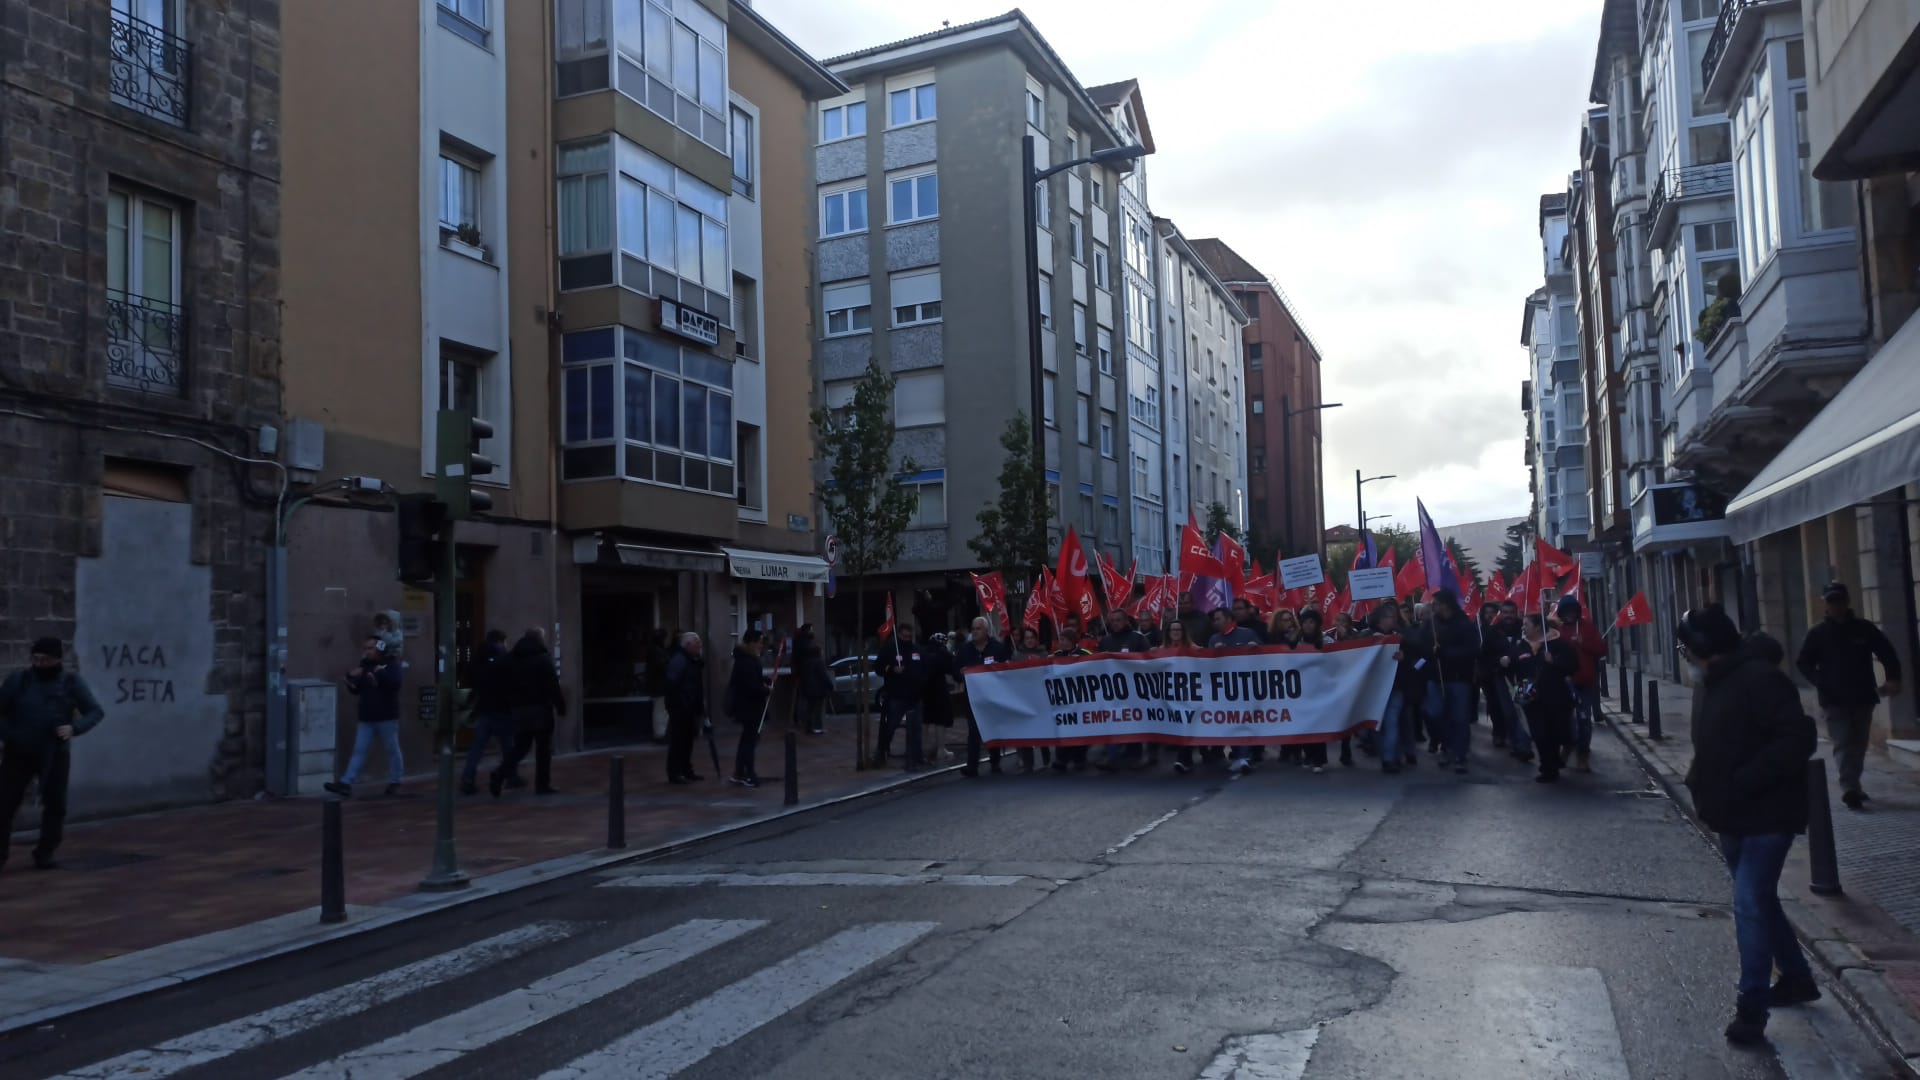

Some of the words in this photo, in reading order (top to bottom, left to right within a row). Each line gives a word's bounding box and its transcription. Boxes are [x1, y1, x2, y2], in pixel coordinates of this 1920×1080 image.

[761, 564, 788, 577] LUMAR
[102, 643, 166, 669] VACA
[115, 678, 175, 704] SETA
[1044, 672, 1129, 706] CAMPOO
[1134, 671, 1203, 702] QUIERE
[1210, 669, 1302, 701] FUTURO
[1055, 712, 1078, 726] SIN
[1082, 708, 1143, 724] EMPLEO
[1147, 708, 1165, 721] NO
[1200, 708, 1292, 725] COMARCA
